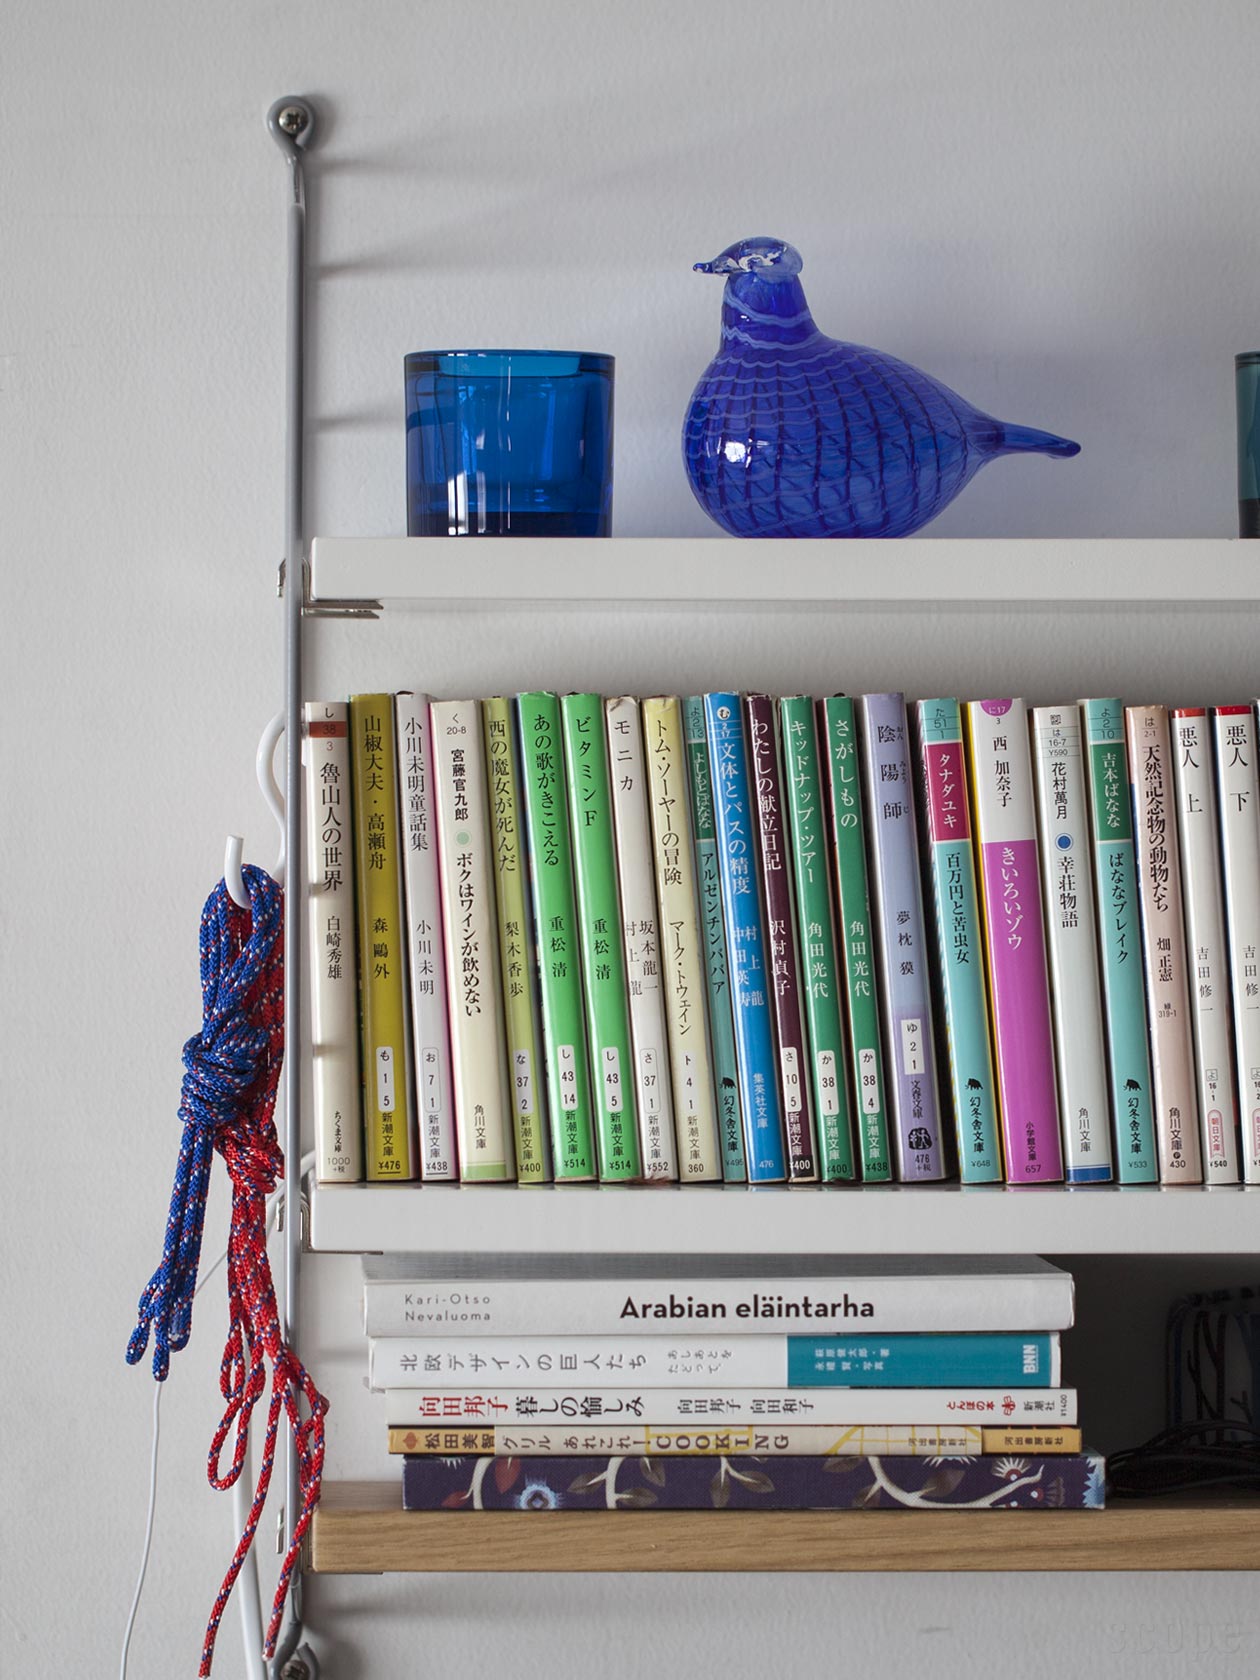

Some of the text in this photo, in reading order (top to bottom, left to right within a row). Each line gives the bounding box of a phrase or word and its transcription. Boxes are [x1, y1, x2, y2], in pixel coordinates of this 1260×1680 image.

[325, 708, 334, 718] し
[447, 726, 466, 736] 20-8
[692, 719, 704, 738] 2 13
[934, 719, 947, 728] 51
[1101, 708, 1114, 739] よ 2 10
[1145, 718, 1155, 727] は
[327, 742, 333, 751] 3
[614, 720, 633, 792] モニカ
[1179, 726, 1203, 813] 悪人 上
[1226, 724, 1250, 812] 悪人 下
[364, 715, 386, 871] 山椒大夫・高瀬舟
[405, 718, 428, 851] 小川未明童話集
[451, 749, 468, 821] 宮藤官九郎
[534, 714, 559, 866] あの歌がきこえる
[576, 716, 597, 826] ビタミンF
[693, 752, 712, 829] よしもとばなな
[835, 719, 857, 828] さがしもの
[878, 726, 902, 820] 陰陽師
[939, 754, 957, 828] タナダユキ
[1051, 762, 1067, 820] 花村萬月
[1101, 753, 1120, 828] 吉本ばなな
[488, 720, 516, 872] 西の魔女が死んだ
[655, 720, 682, 886] トム・ソーヤーの冒険
[753, 719, 782, 870] わたしの献立日記
[791, 720, 816, 882] キッドナップ・ツアー
[320, 762, 343, 892] 魯山人の世界
[719, 742, 751, 895] 文体とパスの精度
[1142, 744, 1168, 912] 天然記念物の動物たち
[946, 852, 969, 964] 百万円と苦虫女
[1002, 847, 1023, 950] きいろいゾウ
[1058, 856, 1078, 928] 幸荘物語
[1110, 853, 1128, 964] ばななブレイク
[457, 853, 482, 1016] ボクはワインが飲めない
[702, 853, 726, 994] アルゼンチンババア
[326, 916, 343, 979] 白崎秀雄
[416, 920, 434, 995] 小川未明
[504, 922, 523, 998] 梨木香歩
[549, 916, 568, 978] 重松清
[593, 918, 611, 981] 重松清
[640, 920, 658, 990] 坂本龍一
[745, 926, 764, 1006] 村上龍
[771, 920, 791, 996] 沢村貞子
[808, 922, 828, 998] 角田光代
[850, 920, 870, 996] 角田光代
[670, 921, 692, 1036] マーク・トウェイン
[1198, 947, 1213, 1011] 吉田修一
[1243, 945, 1259, 1010] 吉田修一
[907, 1023, 918, 1051] ゆ 2
[380, 1050, 390, 1106] も 5
[426, 1053, 435, 1085] お 7
[517, 1054, 528, 1110] な 37 2
[562, 1049, 576, 1104] し 43 14
[606, 1052, 619, 1106] し 43 5
[644, 1076, 656, 1086] 37
[686, 1078, 692, 1087] 4
[785, 1074, 798, 1084] 10
[822, 1055, 835, 1087] か 38
[863, 1053, 876, 1108] か 38 4
[724, 1095, 738, 1153] 幻冬舎文庫
[753, 1073, 768, 1129] 集英社文庫
[791, 1097, 796, 1107] 5
[334, 1111, 342, 1153] ちくま文庫
[382, 1113, 394, 1157] 新潮文庫
[429, 1114, 440, 1158] 新潮文庫
[474, 1104, 487, 1149] 角川文庫
[521, 1116, 533, 1160] 新潮文庫
[565, 1110, 578, 1154] 新潮文庫
[610, 1113, 623, 1157] 新潮文庫
[648, 1115, 661, 1159] 新潮文庫
[688, 1116, 701, 1159] 新潮文庫
[789, 1112, 802, 1156] 新潮文庫
[826, 1116, 840, 1160] 新潮文庫
[867, 1114, 880, 1158] 新潮文庫
[970, 1096, 984, 1153] 幻冬舎文庫
[1026, 1122, 1037, 1161] 小学館文庫
[1078, 1107, 1091, 1153] 角川文庫
[1128, 1098, 1142, 1155] 幻冬舎文庫
[1169, 1107, 1182, 1150] 角川文庫
[379, 1161, 401, 1170] ¥476
[426, 1161, 448, 1170] ¥438
[520, 1163, 541, 1172] ¥400
[564, 1159, 585, 1168] ¥514
[609, 1161, 631, 1170] ¥514
[647, 1162, 669, 1172] ¥552
[688, 1164, 704, 1173] 360
[759, 1160, 774, 1168] 476
[1025, 1165, 1041, 1173] 657
[1170, 1160, 1186, 1168] 430
[404, 1293, 491, 1305] Kari-Otso
[404, 1311, 491, 1322] Nevaluoma
[620, 1293, 875, 1319] Arabian eläintarha
[400, 1353, 648, 1372] 北欧デザインの巨人たち
[668, 1350, 732, 1359] あしあとを
[1023, 1344, 1037, 1374] BNN
[419, 1395, 645, 1418] 向田邦子 暮しの愉しみ
[677, 1398, 814, 1415] 向田邦子 向田和子
[1024, 1400, 1055, 1411] 新潮社
[503, 1435, 551, 1450] グリル
[656, 1434, 790, 1450] COOKING
[1004, 1436, 1063, 1445] 河出書房新社
